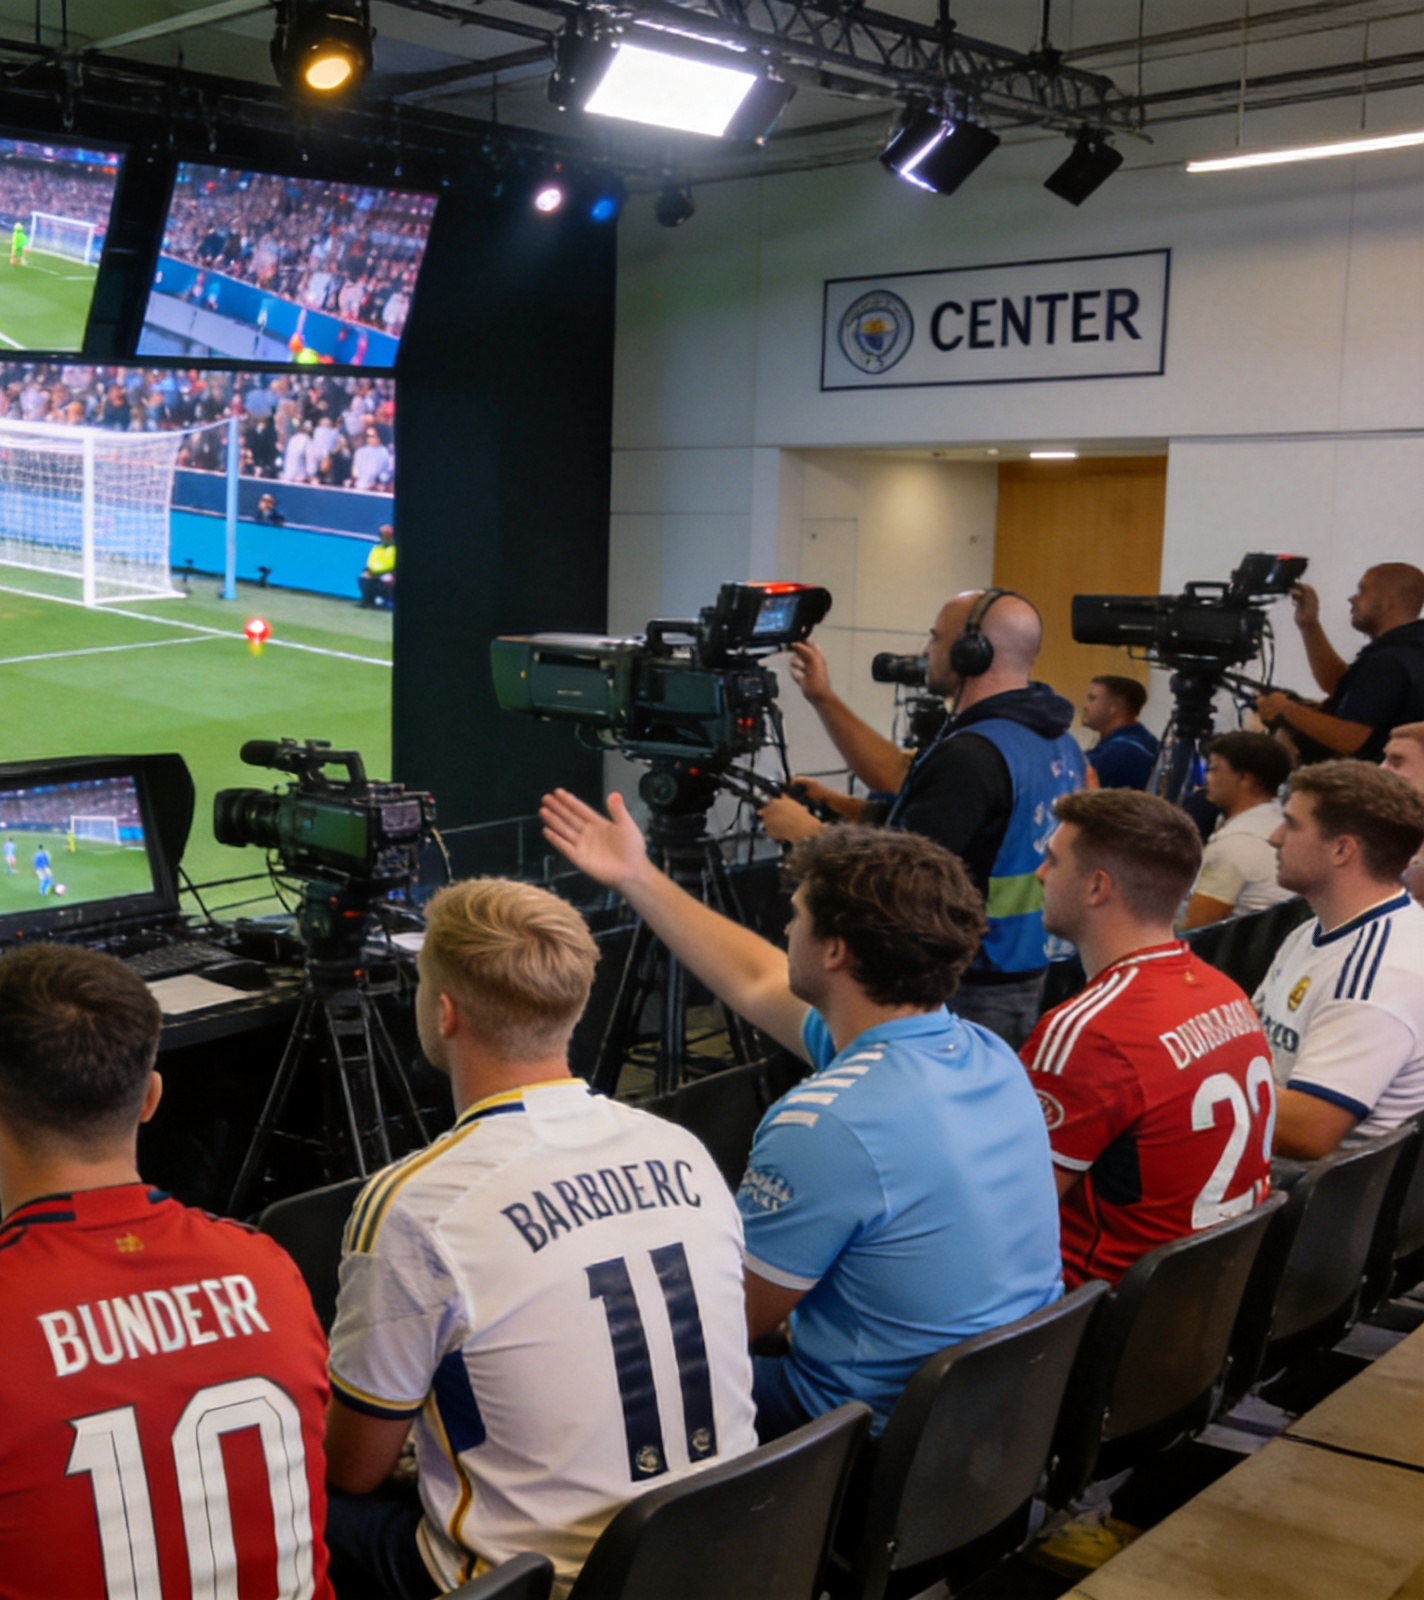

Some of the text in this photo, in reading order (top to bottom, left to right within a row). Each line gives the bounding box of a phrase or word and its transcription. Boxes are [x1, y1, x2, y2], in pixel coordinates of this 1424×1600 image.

[930, 288, 1142, 352] CENTER
[584, 1242, 718, 1482] 11
[65, 1375, 316, 1600] 10
